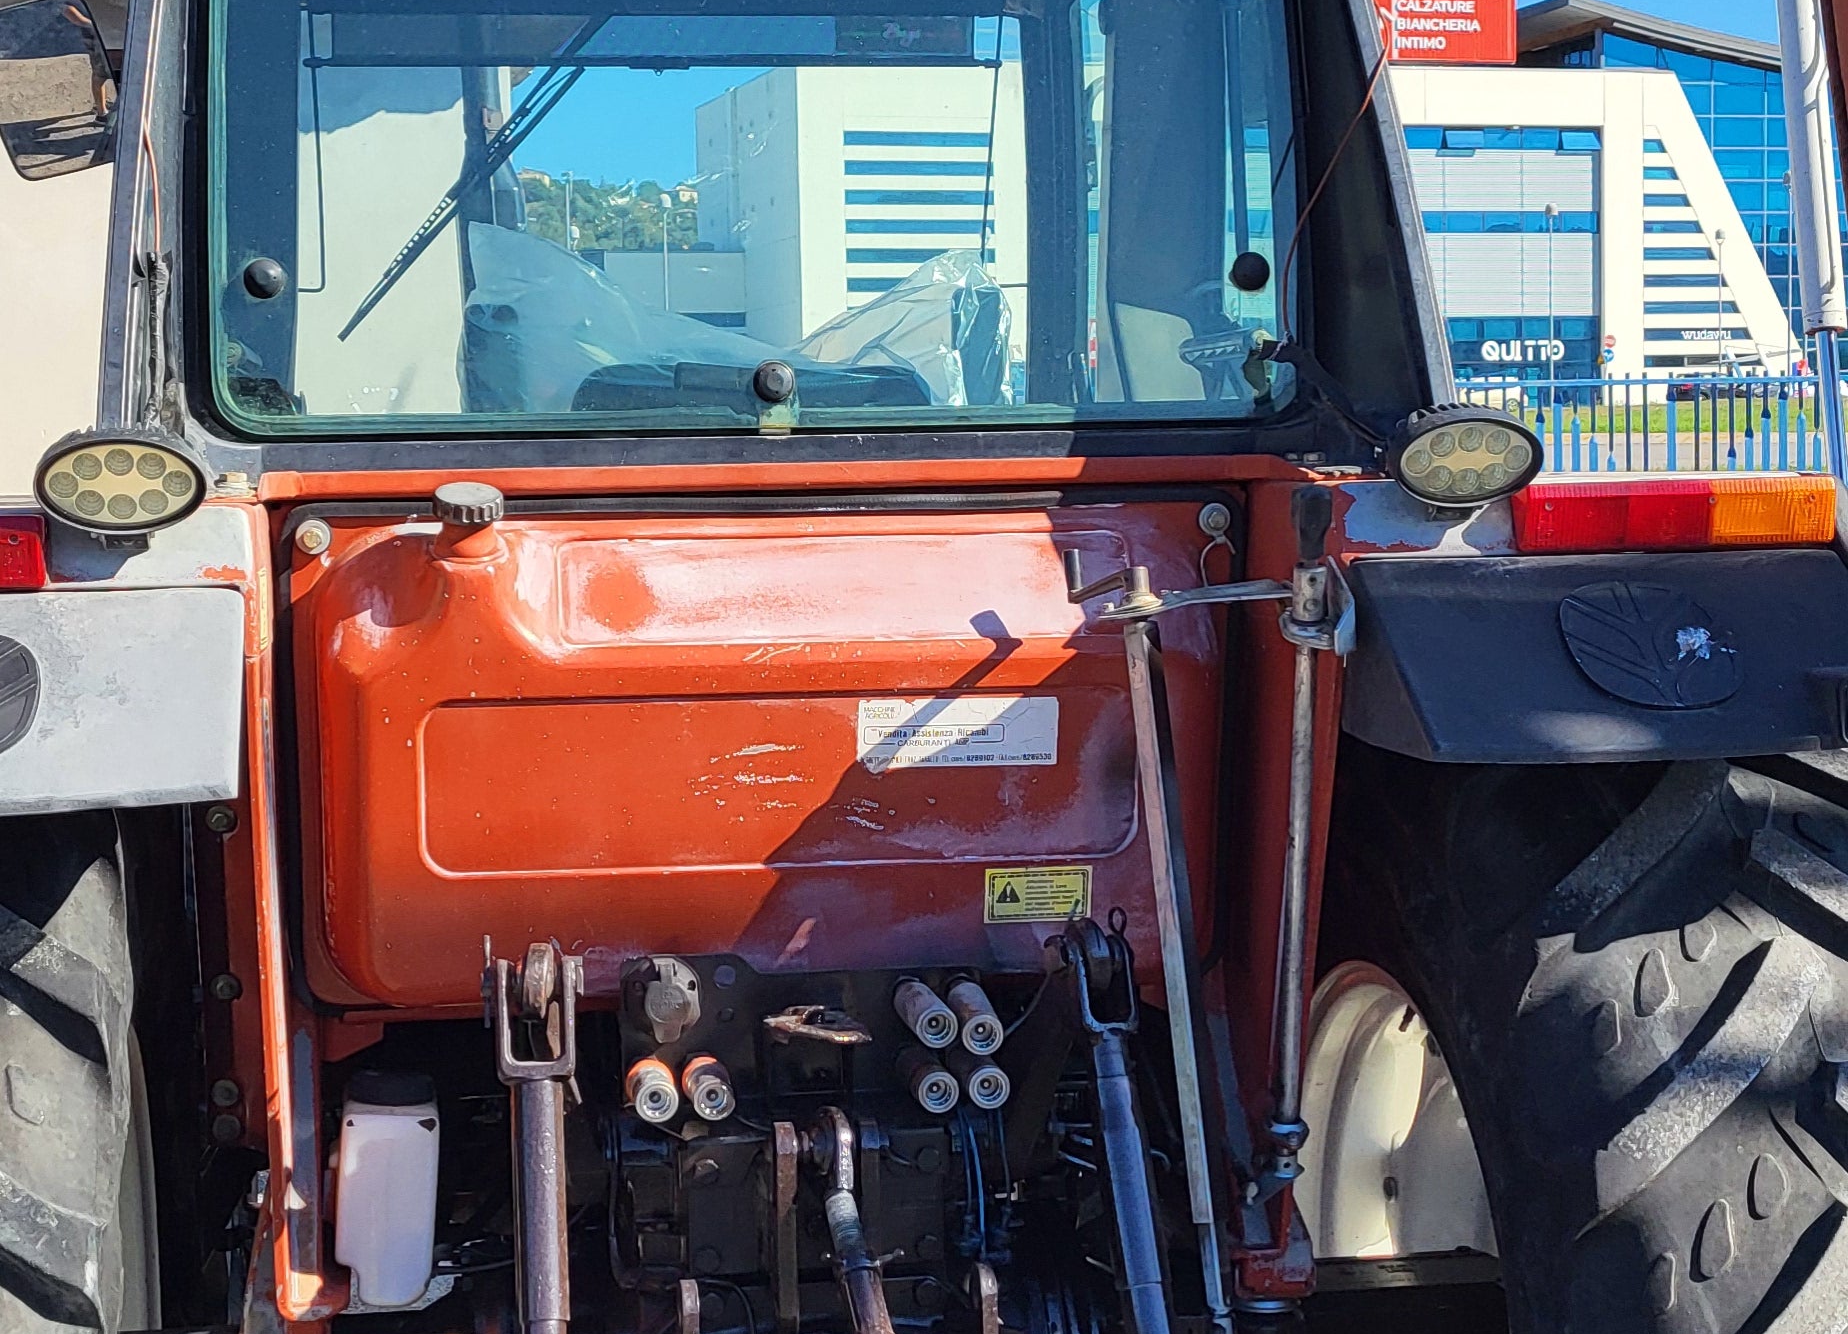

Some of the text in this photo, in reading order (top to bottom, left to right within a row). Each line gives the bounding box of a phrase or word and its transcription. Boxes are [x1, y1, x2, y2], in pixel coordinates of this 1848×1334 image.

[1396, 17, 1482, 32] BIANCHERIA
[1396, 36, 1446, 50] INTIMO
[1681, 329, 1732, 340] wudawu
[1481, 339, 1565, 361] QUITTO
[878, 729, 908, 738] Vendita
